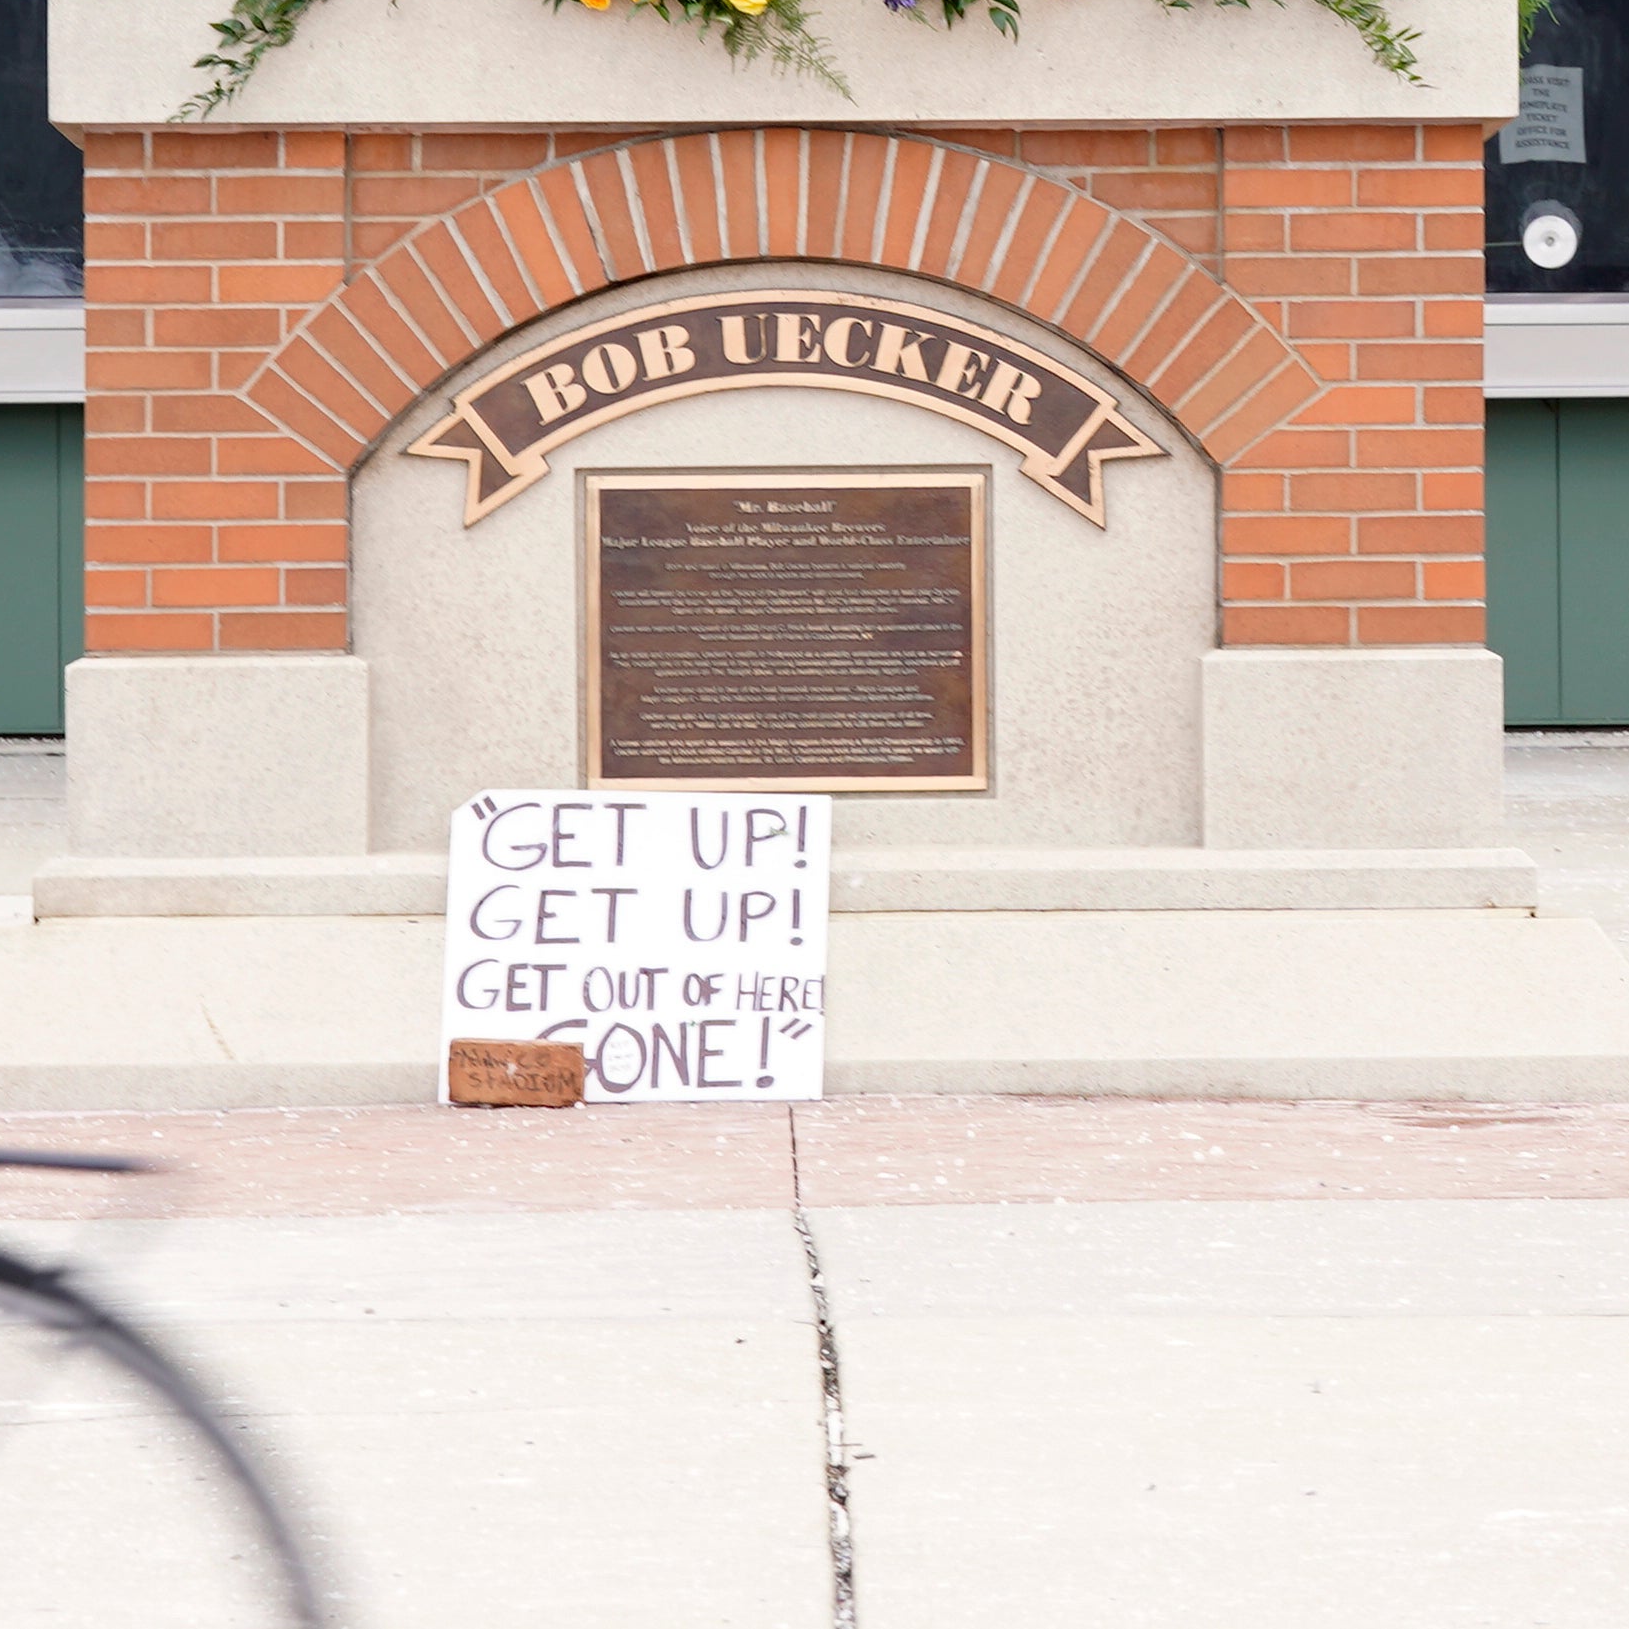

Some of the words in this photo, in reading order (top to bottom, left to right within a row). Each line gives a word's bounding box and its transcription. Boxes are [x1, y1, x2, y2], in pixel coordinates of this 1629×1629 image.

[520, 323, 698, 427] BOB
[716, 312, 1044, 427] UECKER
[690, 805, 808, 870] UP!
[470, 884, 639, 945] GET
[683, 887, 804, 947] UP!
[456, 958, 568, 1012] GET
[582, 966, 669, 1013] OUT
[682, 972, 724, 1007] OF
